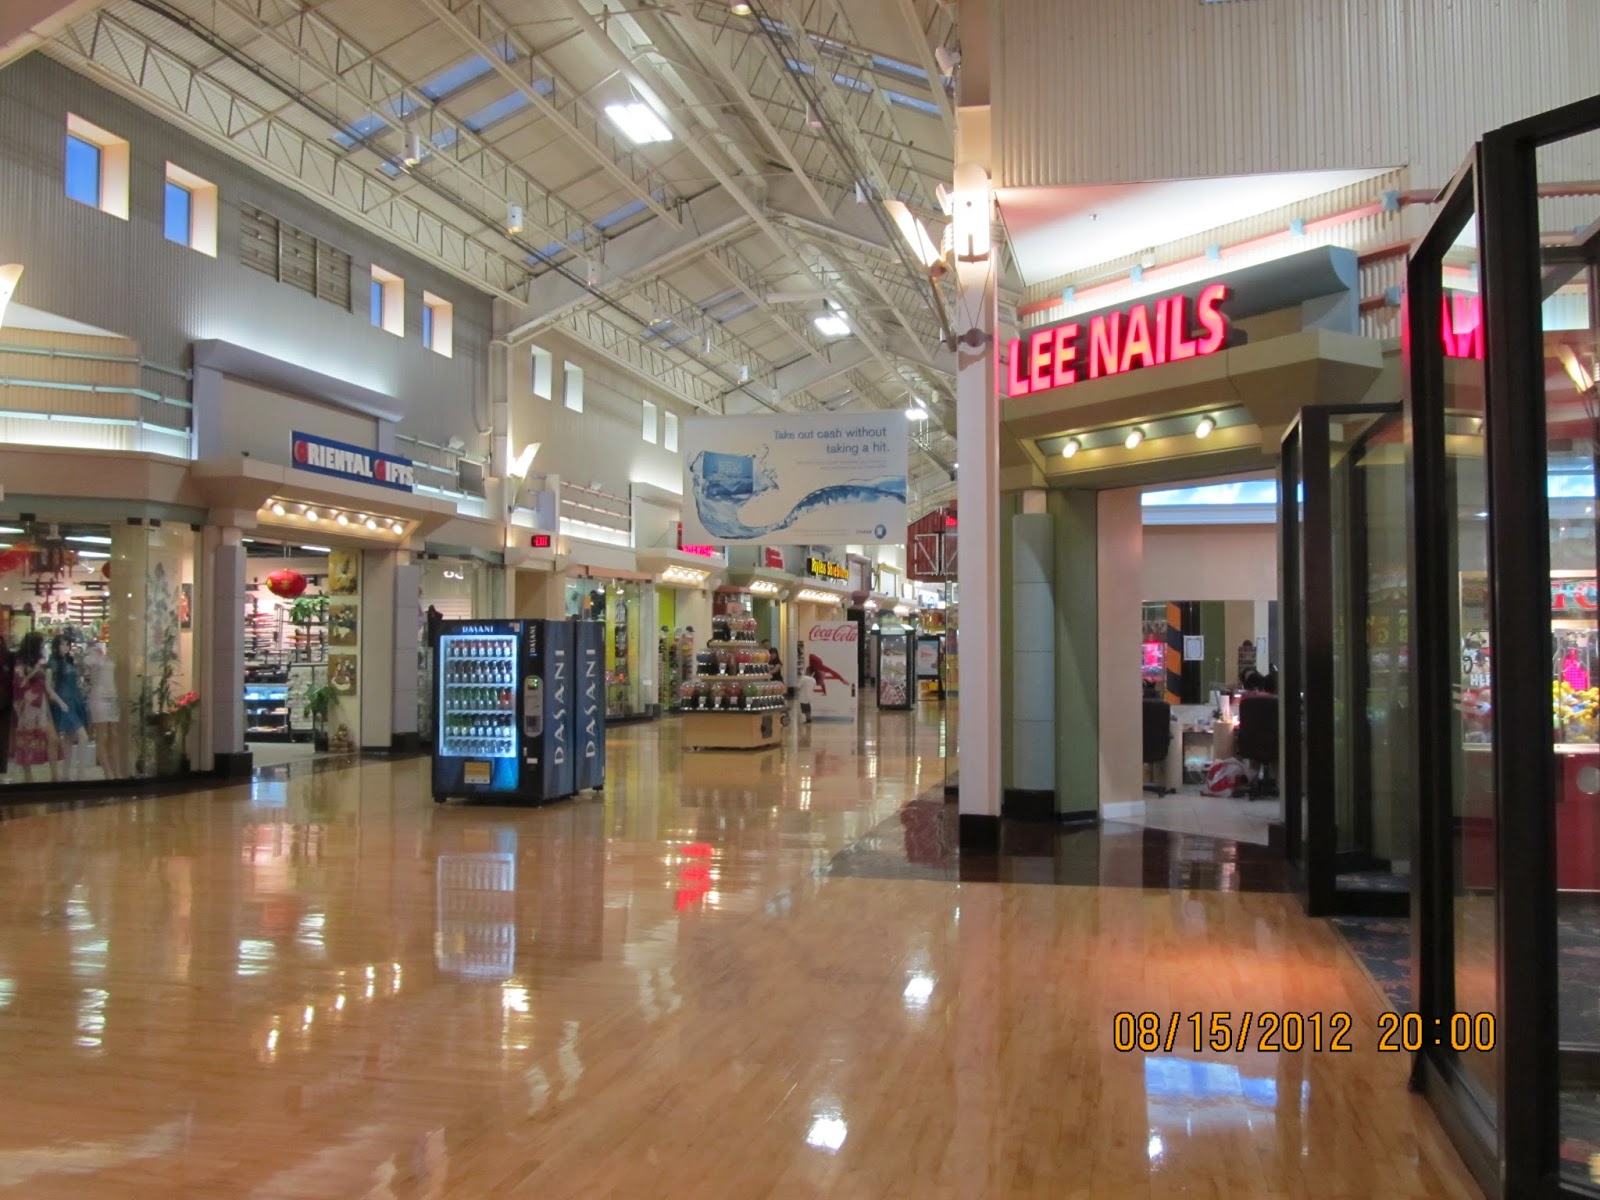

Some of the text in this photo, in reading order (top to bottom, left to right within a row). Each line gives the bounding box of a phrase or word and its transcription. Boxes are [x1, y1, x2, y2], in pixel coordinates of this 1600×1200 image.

[1008, 283, 1228, 397] LEE NAILS
[774, 427, 887, 440] Take out cash without
[826, 441, 890, 455] taking a hit.
[294, 440, 414, 486] ORIENTAL GIFTS
[462, 625, 494, 634] DASANI
[529, 624, 537, 653] DASANI
[809, 624, 858, 642] Coca-Cola
[553, 650, 566, 764] DASANI
[585, 649, 597, 758] DASANI
